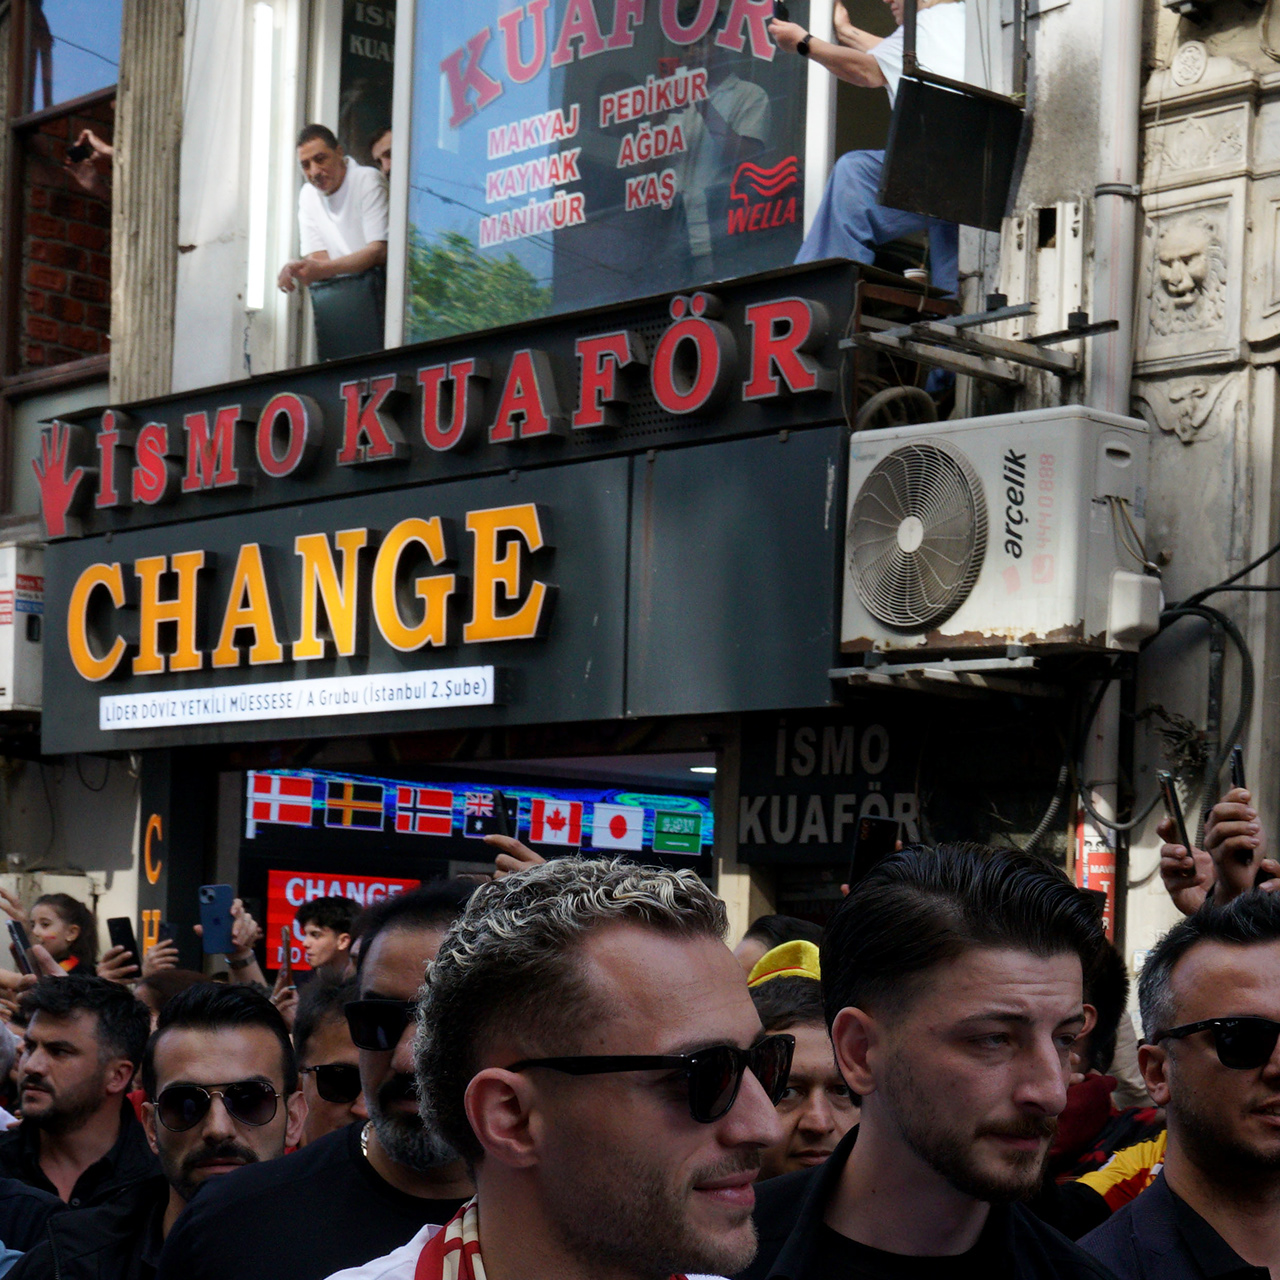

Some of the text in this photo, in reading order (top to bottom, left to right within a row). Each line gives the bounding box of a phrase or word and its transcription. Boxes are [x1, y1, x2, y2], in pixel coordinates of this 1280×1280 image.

[600, 66, 708, 128] PEDİKÜR
[488, 104, 580, 160] MAKYAJ
[618, 121, 686, 168] AĞDA
[486, 147, 582, 203] KAYNAK
[626, 169, 677, 211] KAŞ
[480, 191, 585, 248] MANİKÜR
[728, 197, 796, 235] WELLA
[95, 292, 820, 509] İSMO KUAFÖR
[1003, 448, 1029, 559] arçelik
[66, 502, 547, 682] CHANGE
[106, 703, 138, 722] LİDER
[142, 699, 177, 719] DÖVİZ
[181, 694, 226, 716] YETKİLİ
[230, 691, 293, 712] MÜESSESE
[307, 691, 315, 706] A
[320, 688, 359, 706] Grubu
[363, 681, 427, 706] (İstanbul
[775, 718, 890, 777] İSMO
